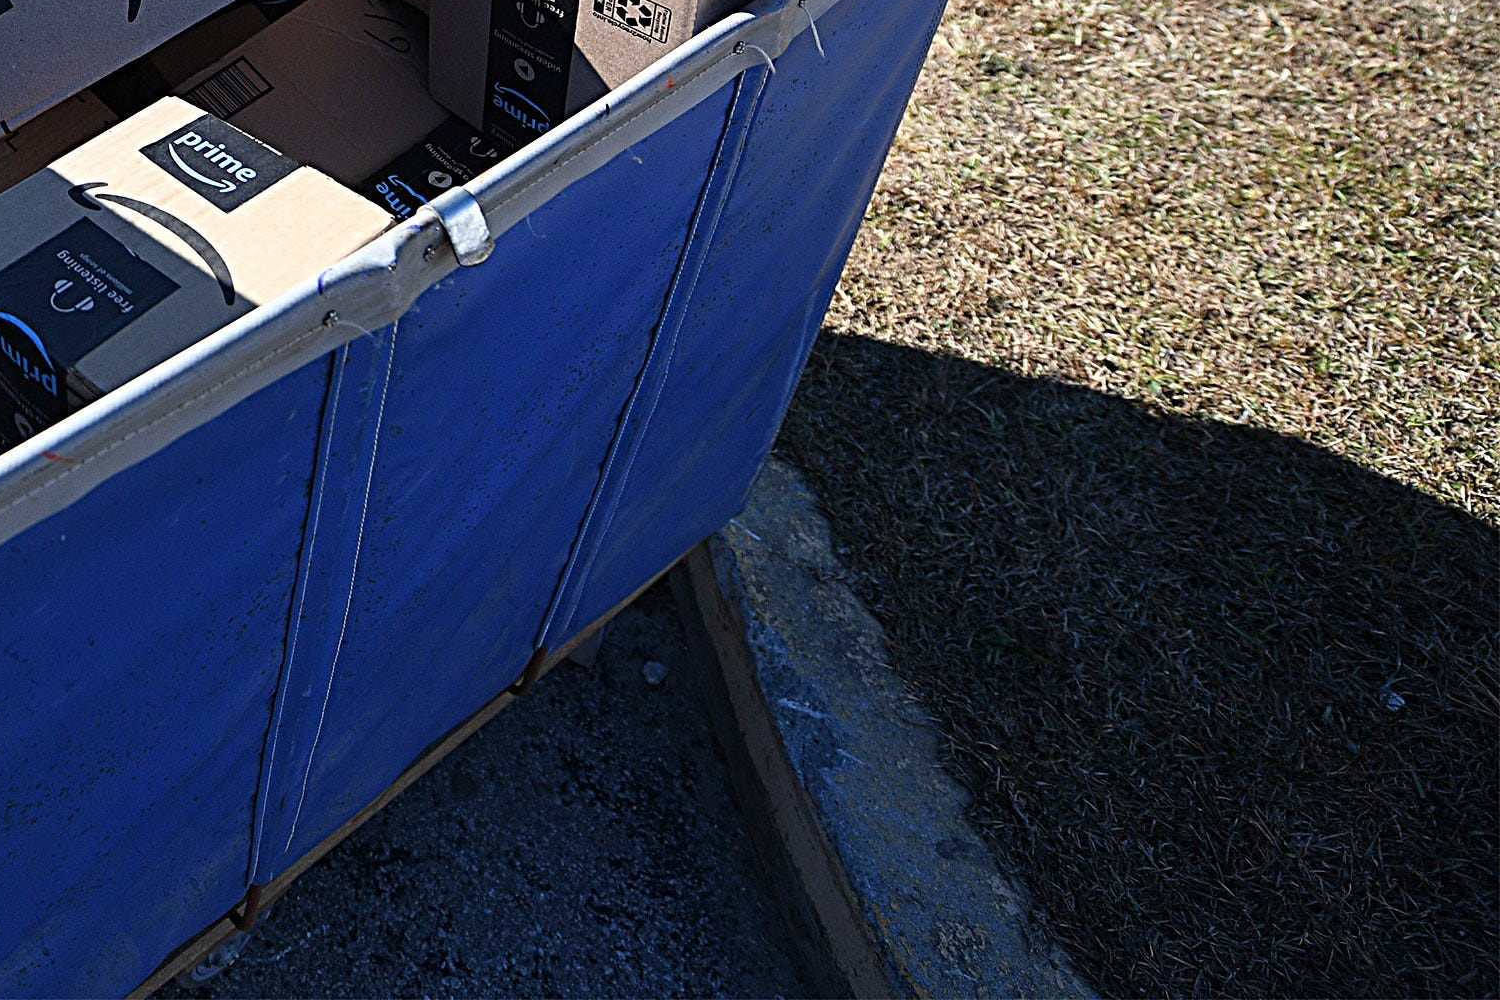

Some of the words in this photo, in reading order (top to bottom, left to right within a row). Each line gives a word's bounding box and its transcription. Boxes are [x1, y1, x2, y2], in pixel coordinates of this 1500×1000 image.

[543, 1, 565, 19] free
[592, 11, 652, 44] how2recycle.info
[173, 131, 257, 183] prime
[56, 249, 108, 295] listening
[107, 290, 135, 315] free
